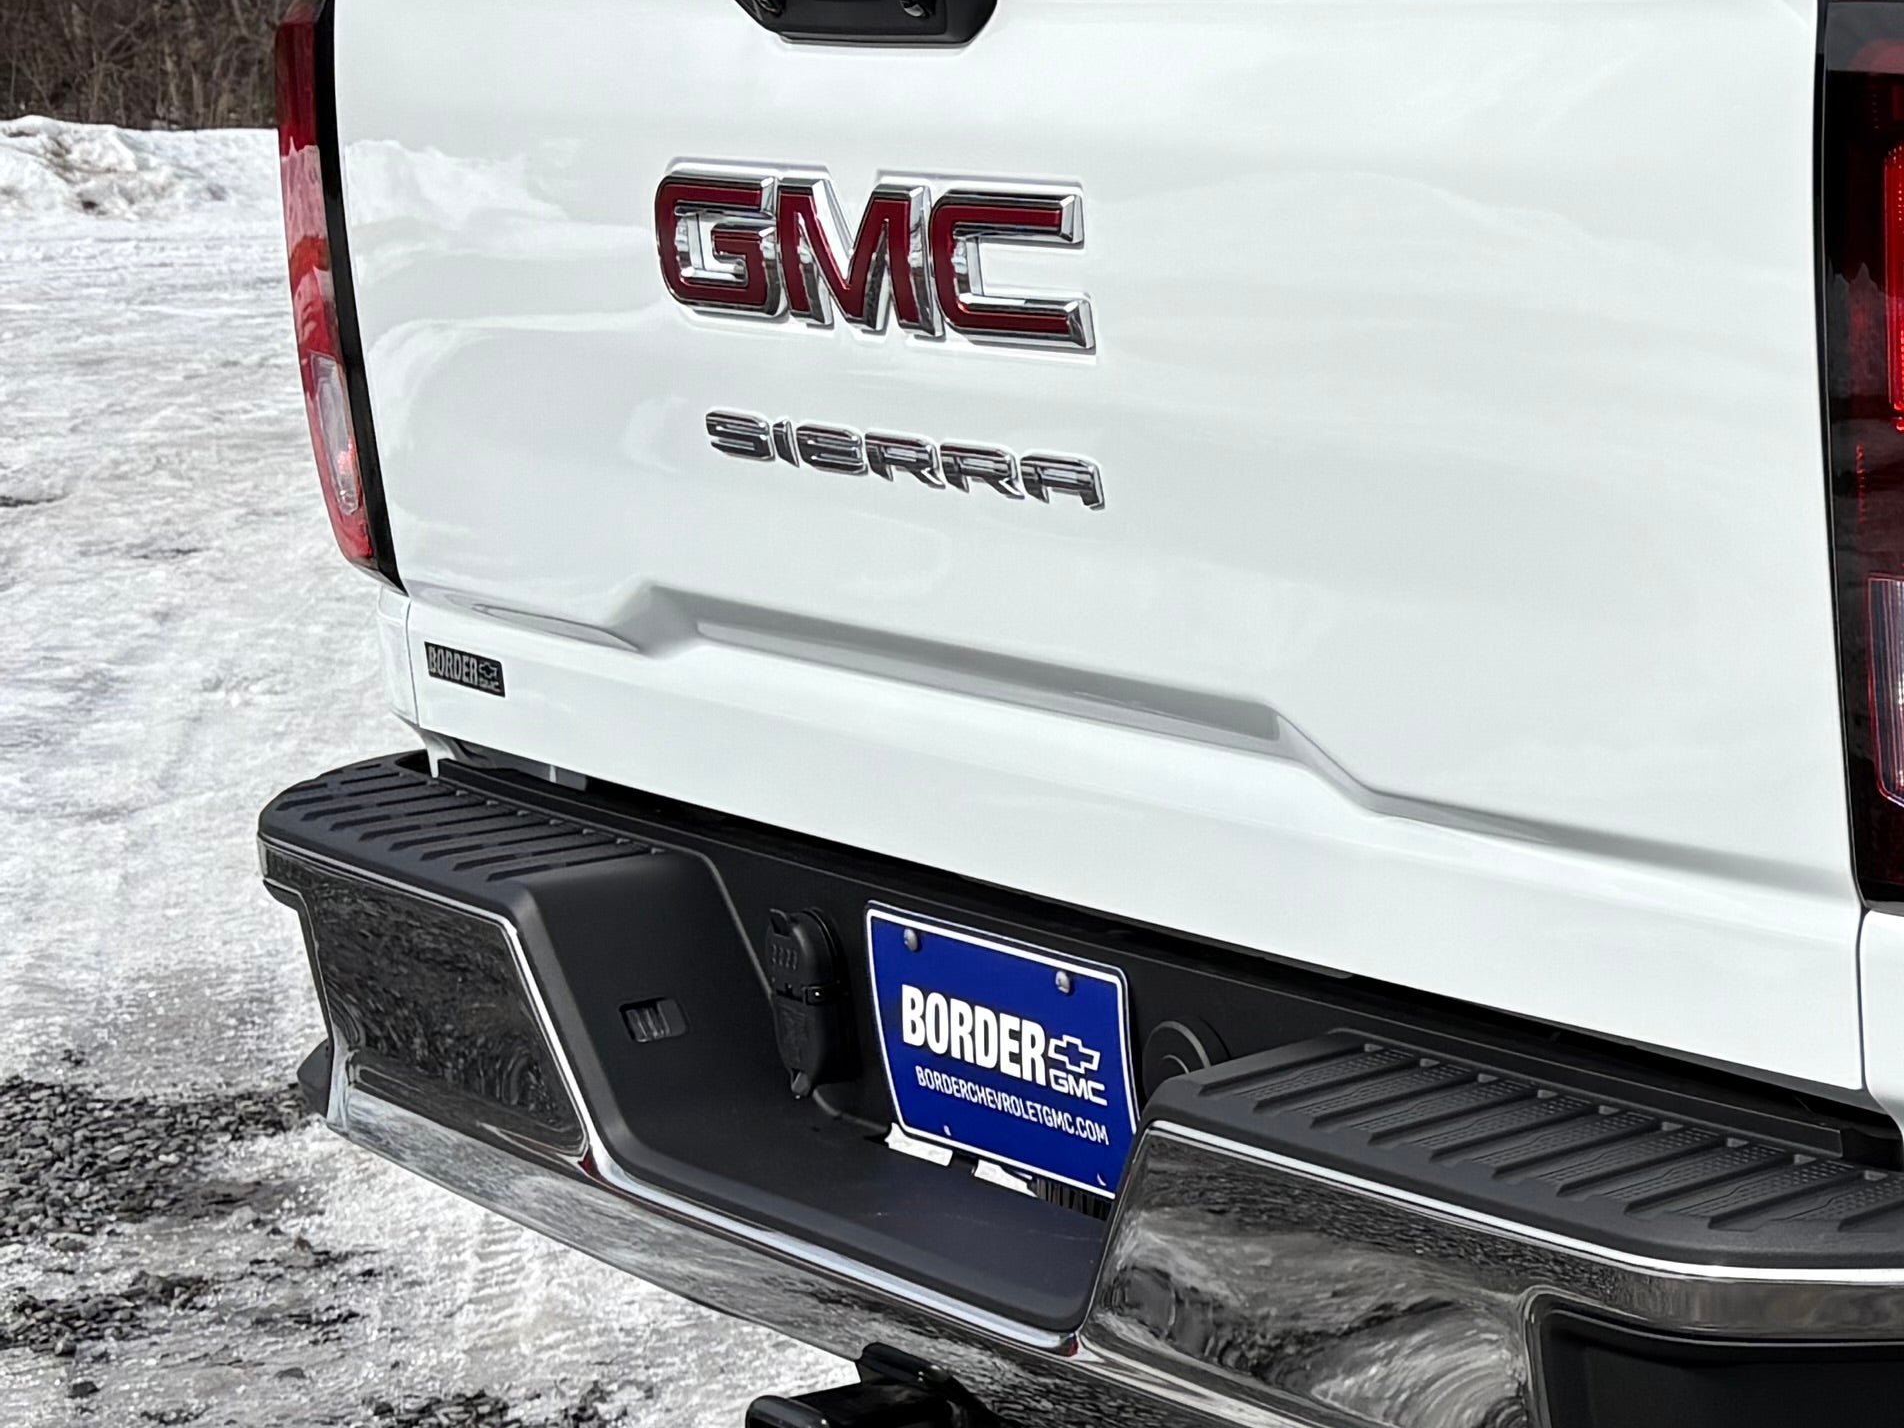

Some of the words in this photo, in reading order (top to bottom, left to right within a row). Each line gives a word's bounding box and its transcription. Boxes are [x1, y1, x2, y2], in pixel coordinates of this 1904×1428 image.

[654, 174, 1096, 355] GMC
[704, 408, 1106, 510] SIERRA
[427, 645, 478, 686] BORDER
[902, 984, 1047, 1086] BORDER
[915, 1065, 1110, 1146] BORDERCHEVROLETGMC.COM
[1049, 1068, 1108, 1106] GMC
